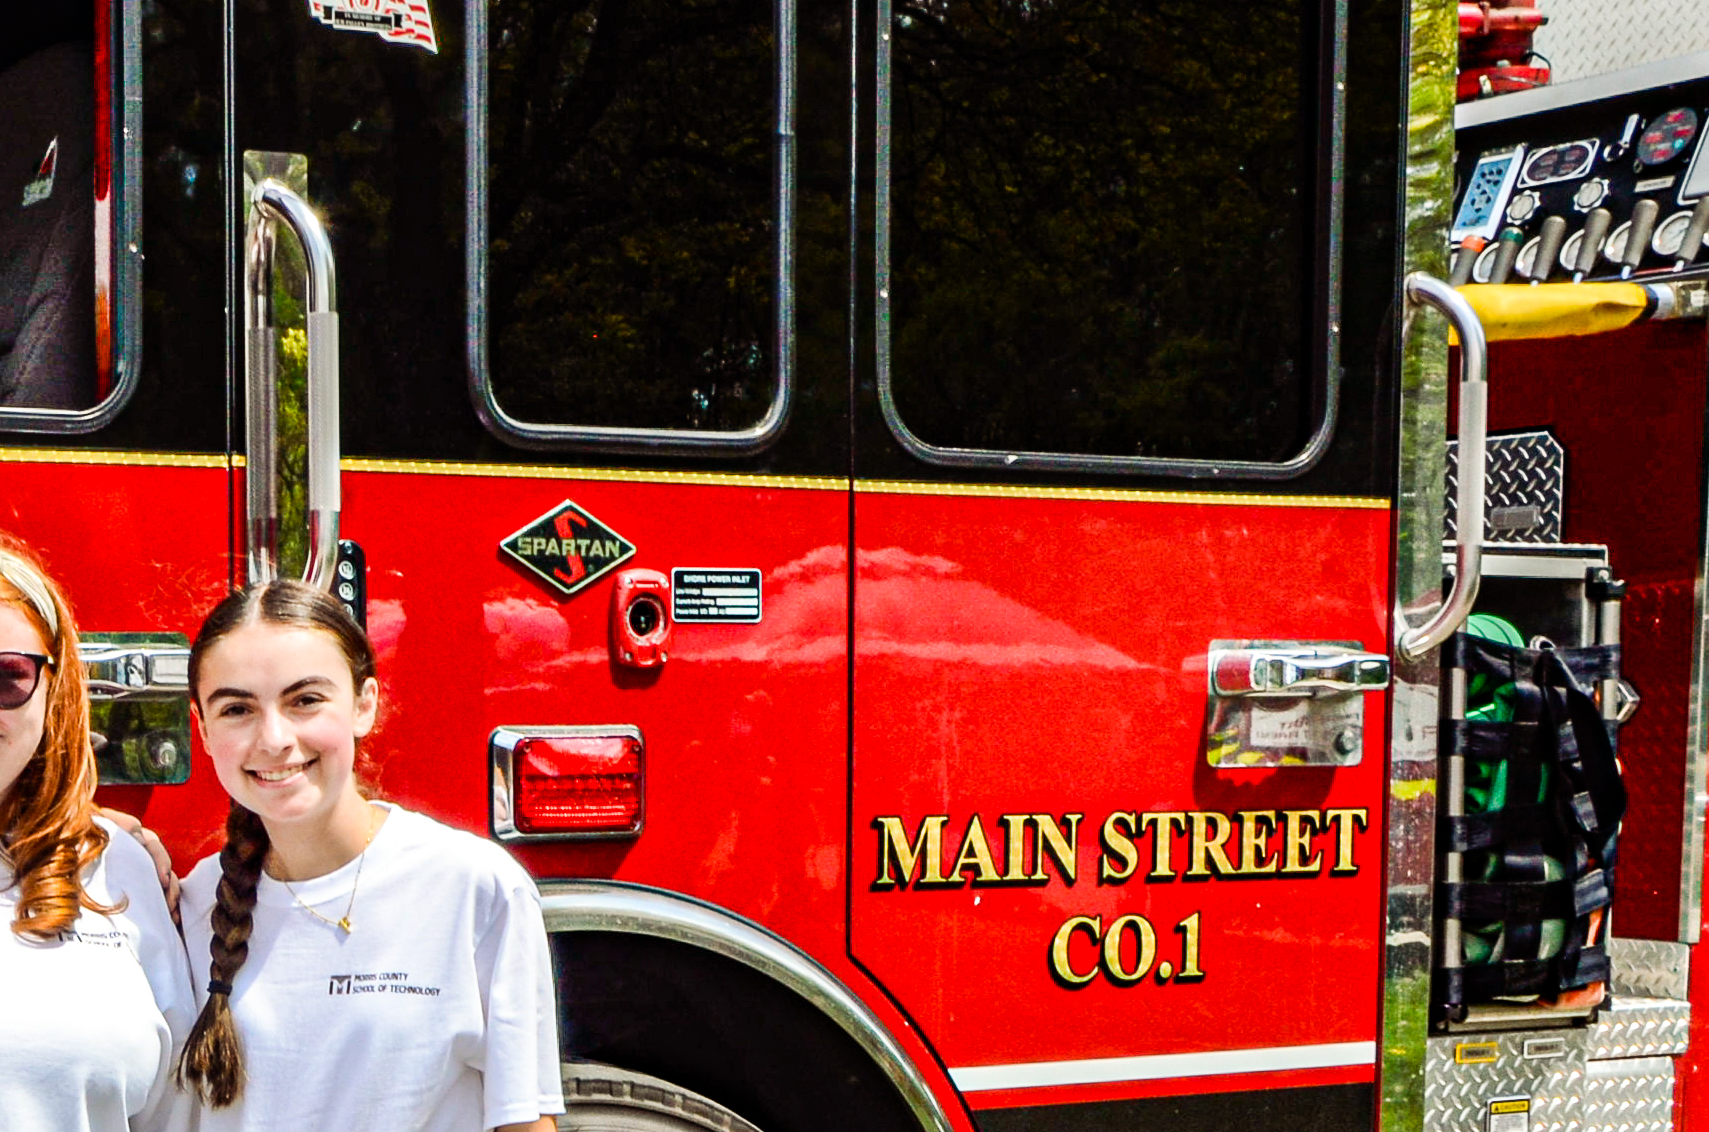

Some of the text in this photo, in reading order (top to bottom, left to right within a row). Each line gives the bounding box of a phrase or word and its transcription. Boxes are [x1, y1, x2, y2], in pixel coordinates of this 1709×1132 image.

[517, 536, 621, 558] SPARTAN
[872, 808, 1369, 888] MAIN STREET
[1049, 911, 1206, 987] CO.1
[354, 972, 408, 982] MORRIS COUNTY
[352, 984, 441, 996] SCHOOL OF TECHNOLOGY
